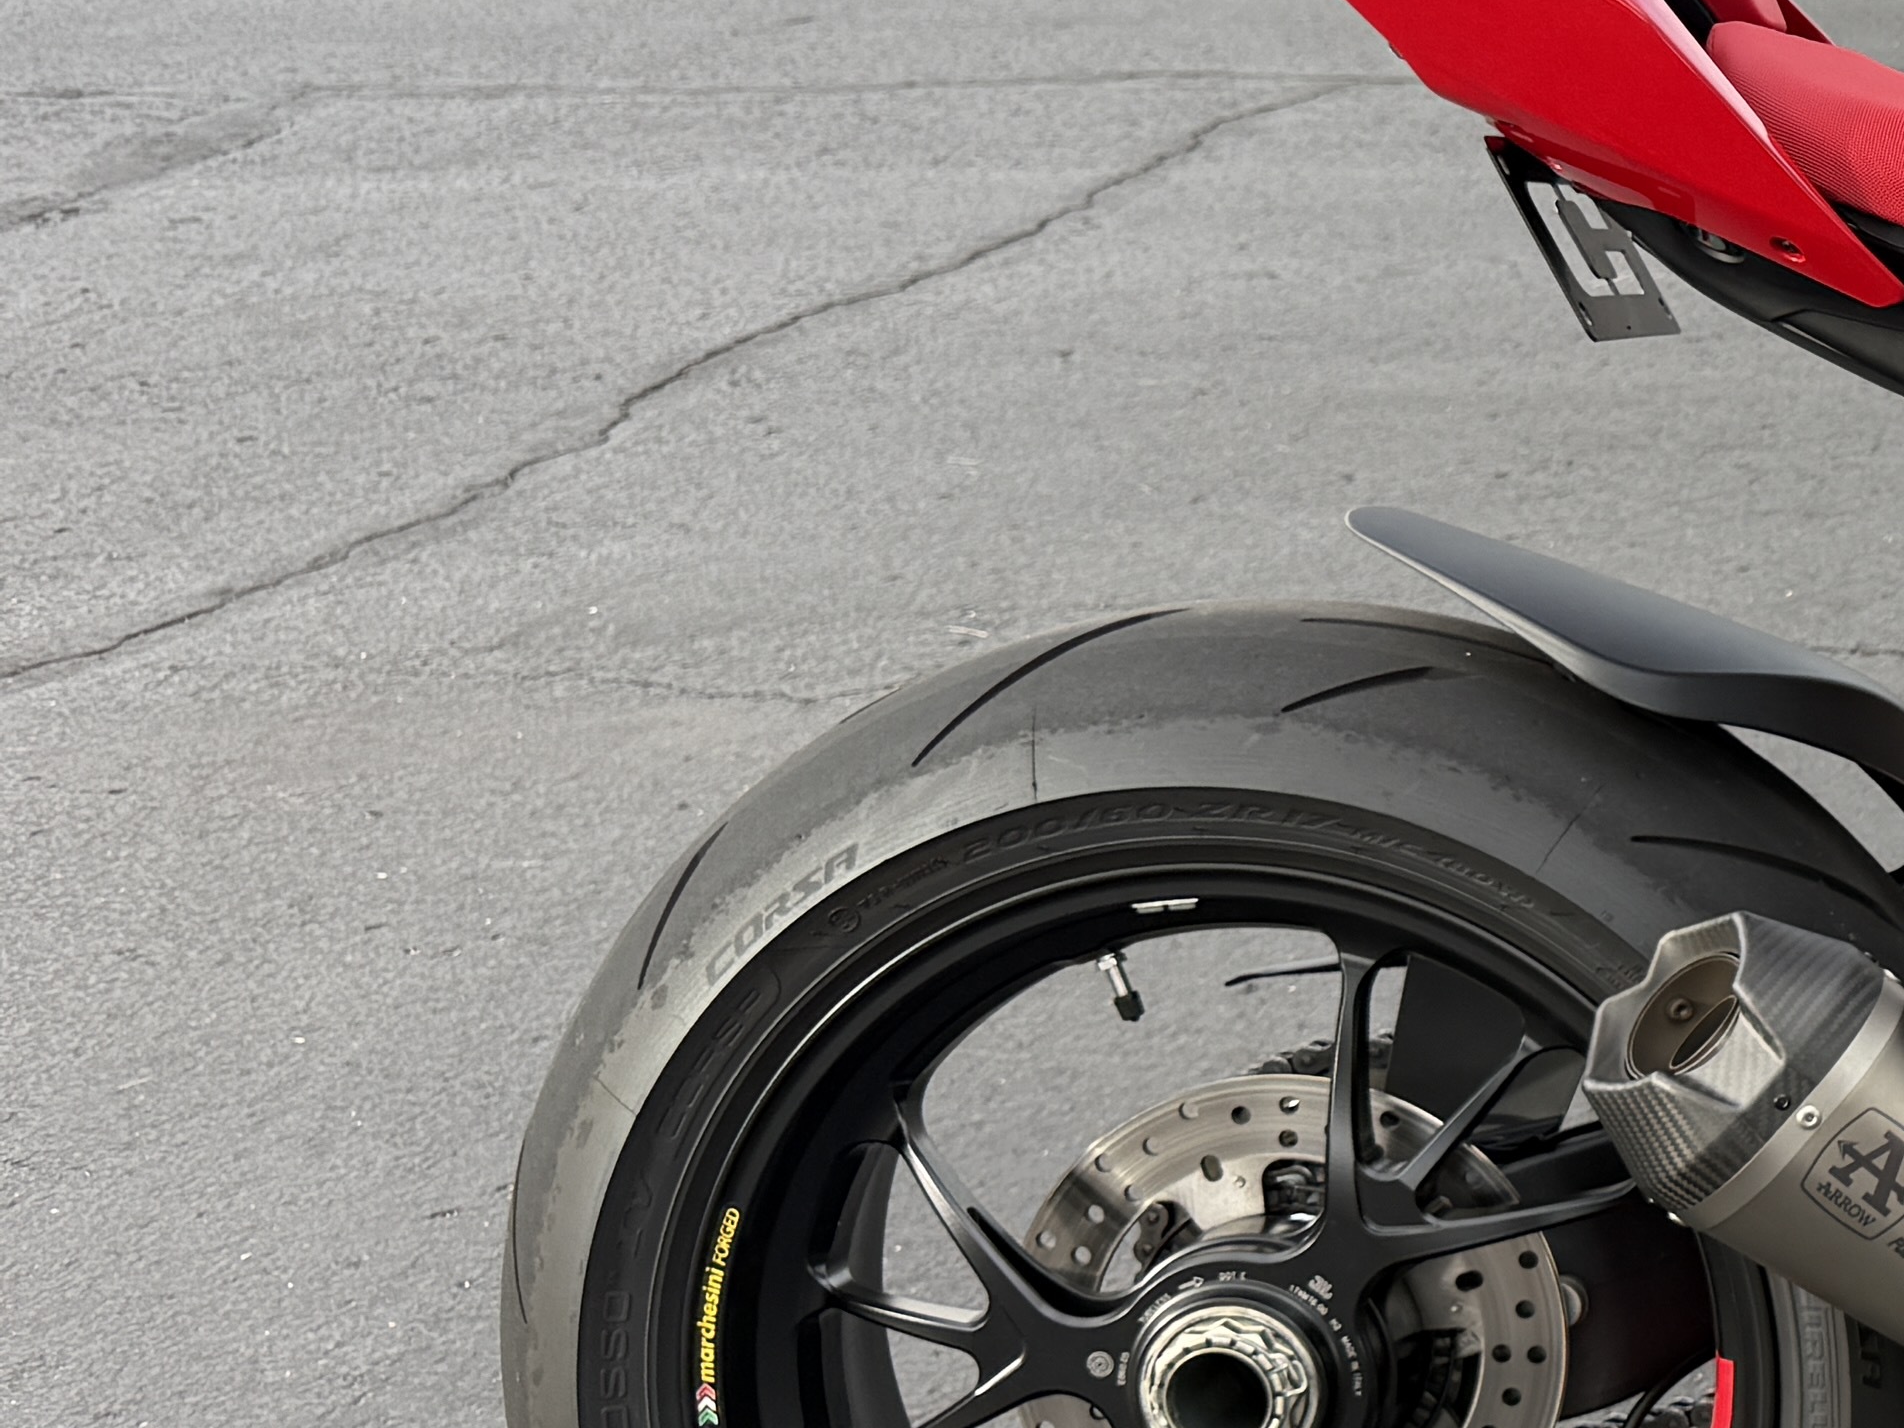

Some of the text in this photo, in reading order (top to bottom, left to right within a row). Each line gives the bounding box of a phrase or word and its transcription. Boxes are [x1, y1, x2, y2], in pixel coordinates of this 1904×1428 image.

[705, 842, 860, 988] CORSA
[1815, 1180, 1877, 1228] ARROW
[696, 1205, 741, 1385] marchesini FORGED
